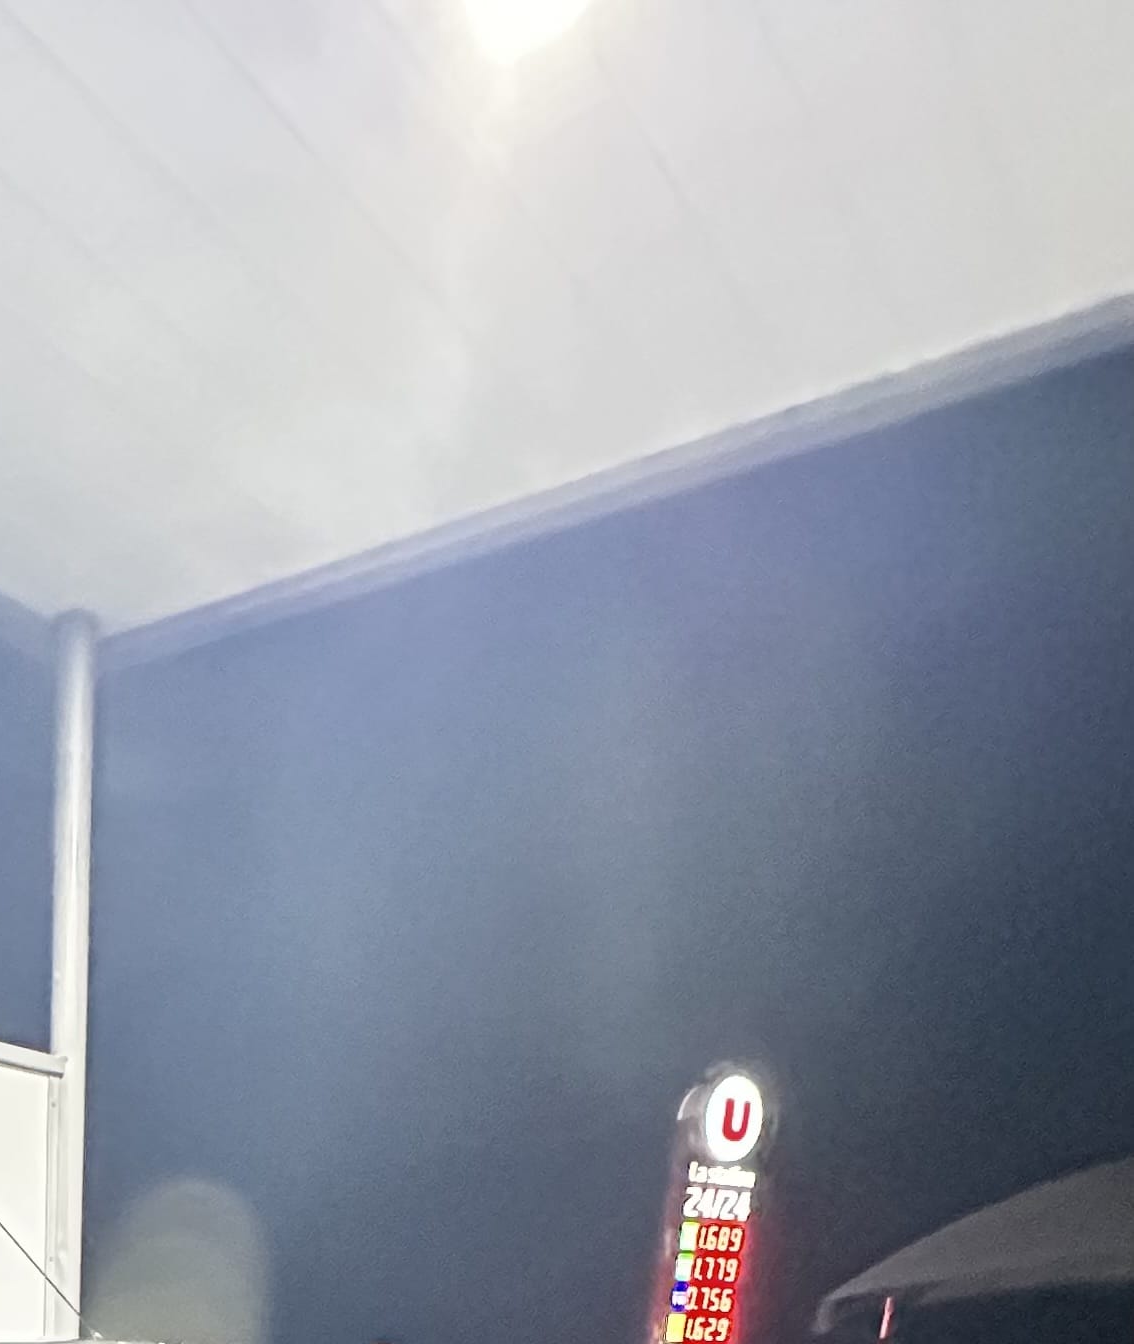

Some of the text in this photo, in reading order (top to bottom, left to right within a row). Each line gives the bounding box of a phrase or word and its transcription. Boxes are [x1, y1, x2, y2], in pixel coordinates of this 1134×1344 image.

[723, 1098, 751, 1142] U
[683, 1186, 751, 1222] 24/24
[699, 1225, 743, 1252] 1.689
[685, 1317, 729, 1342] 1.629
